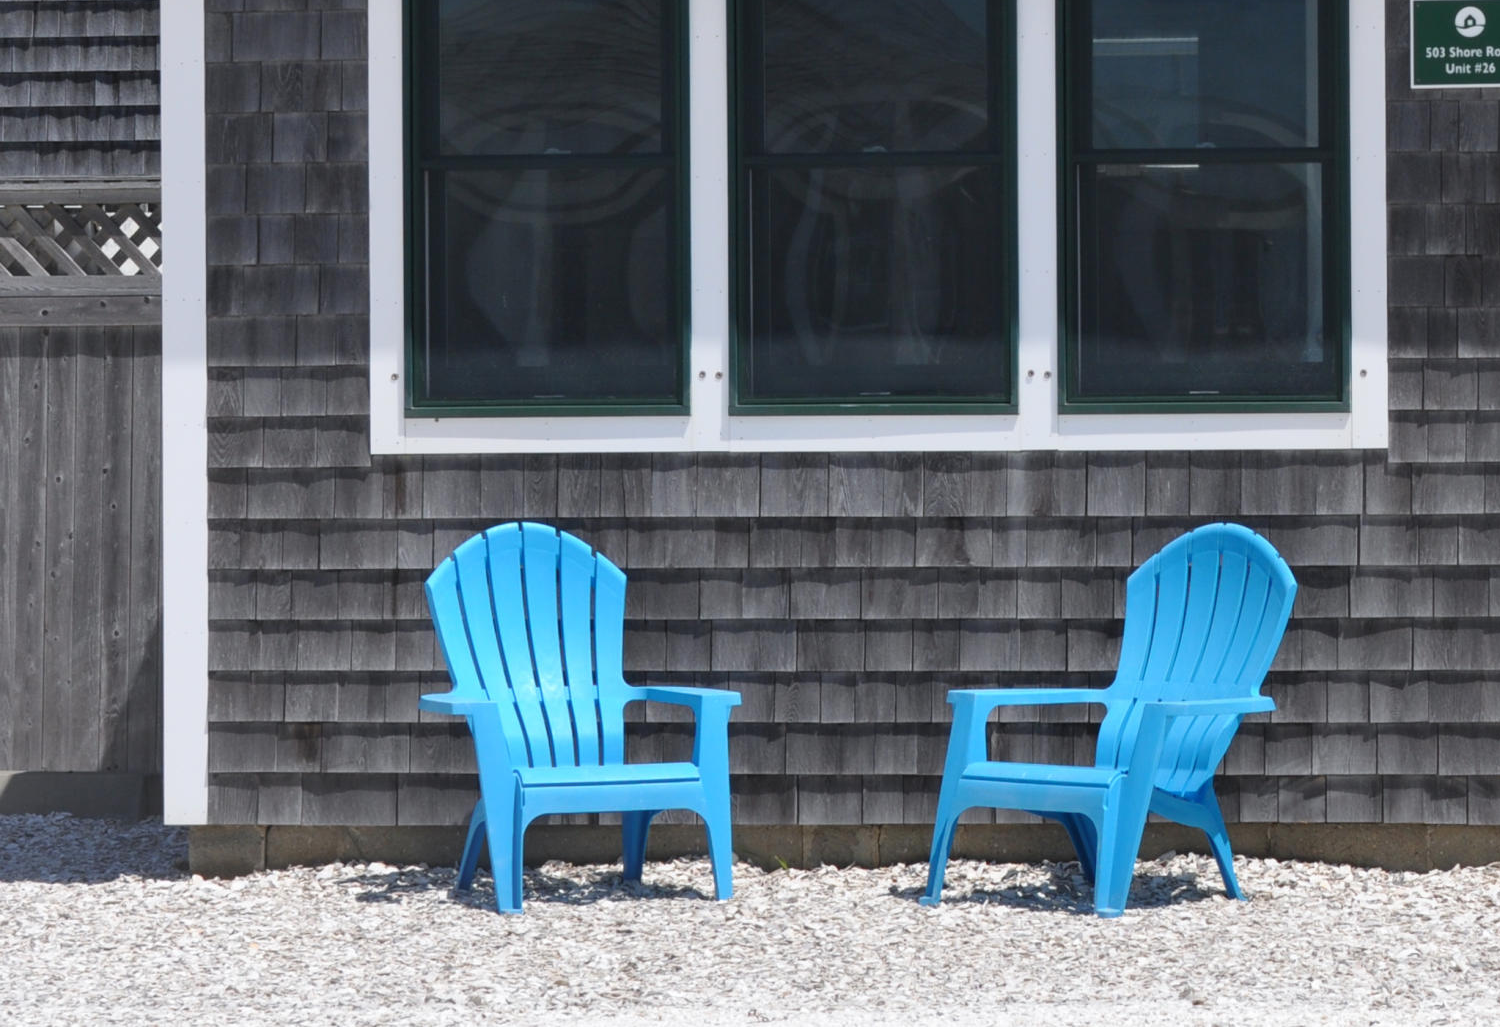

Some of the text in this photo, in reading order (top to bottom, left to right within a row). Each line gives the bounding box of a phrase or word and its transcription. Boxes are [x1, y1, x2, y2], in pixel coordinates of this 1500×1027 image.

[1425, 46, 1446, 59] 503
[1449, 46, 1483, 58] Shore
[1445, 62, 1496, 74] Unit #26
